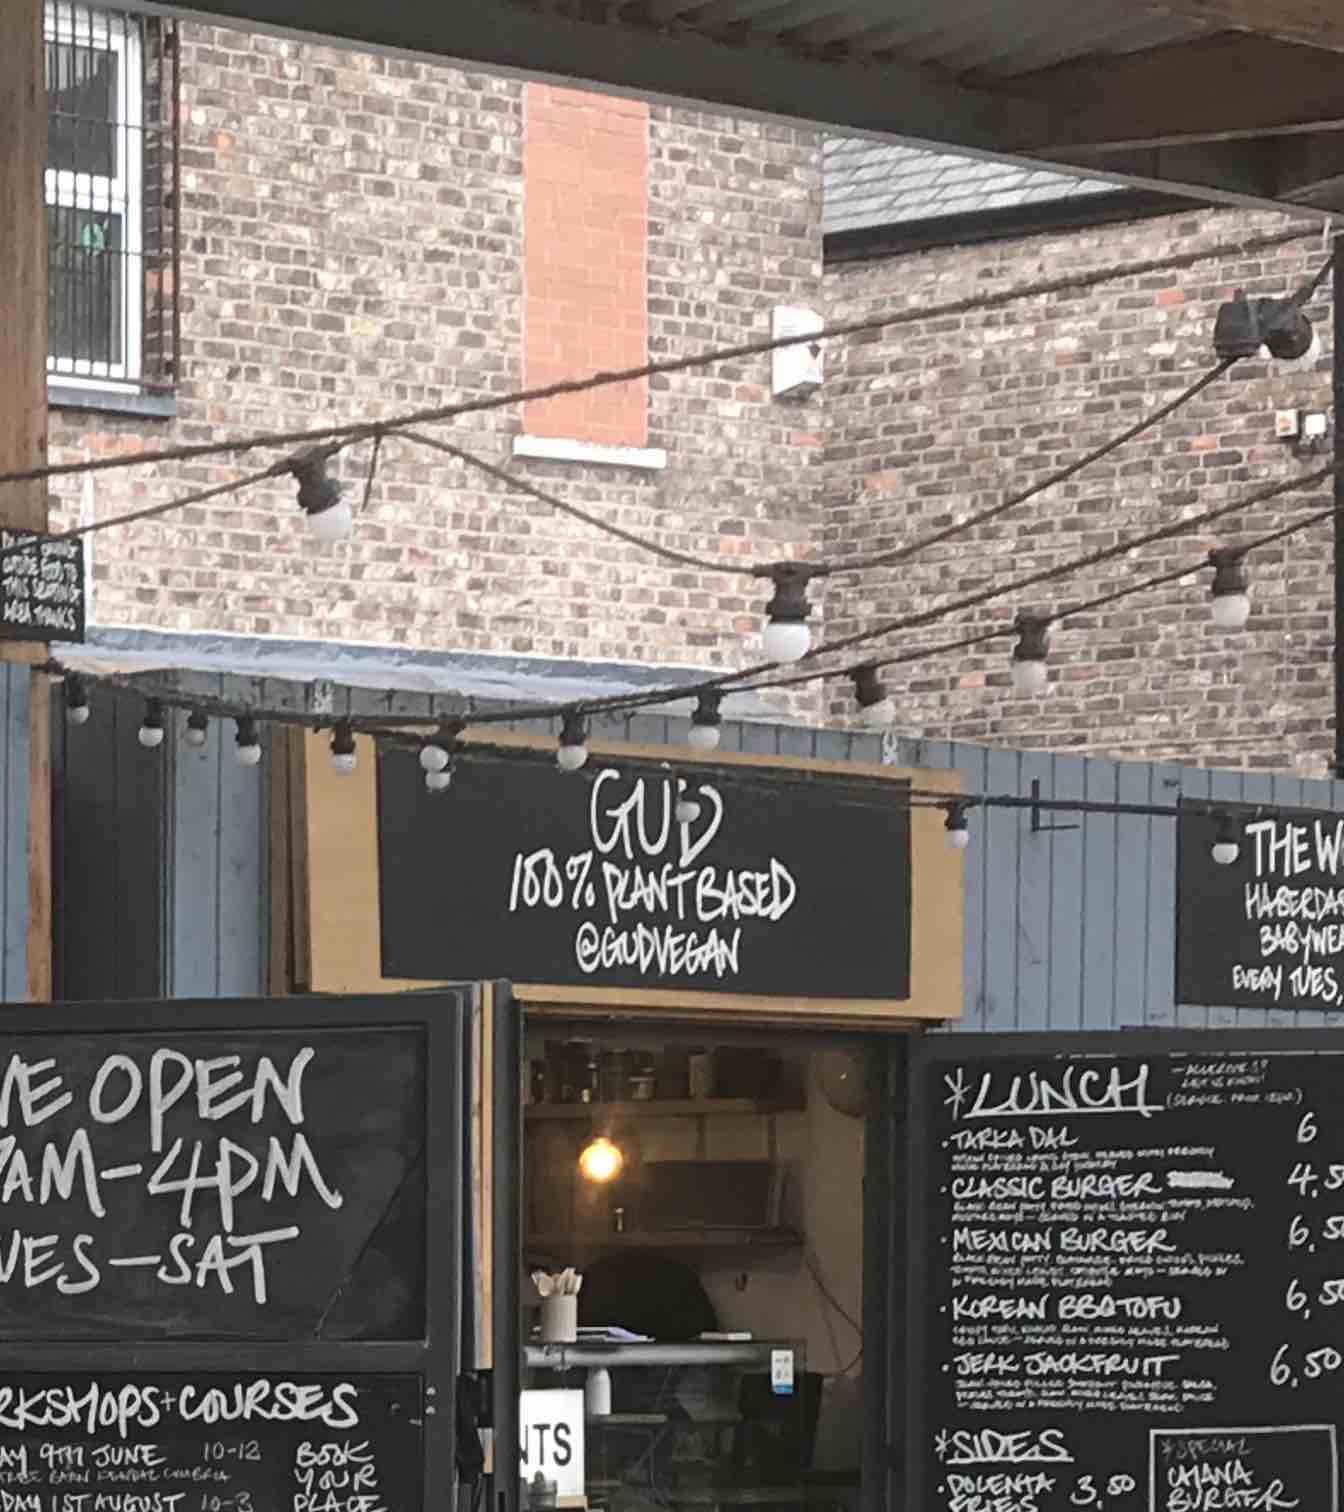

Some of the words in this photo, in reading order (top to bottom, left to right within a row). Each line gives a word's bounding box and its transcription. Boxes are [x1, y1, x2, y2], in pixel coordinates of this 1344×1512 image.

[590, 768, 724, 868] GUD
[1245, 820, 1311, 877] THE
[509, 848, 595, 911] 100%
[605, 862, 699, 924] PLANT
[696, 857, 796, 923] BASED
[575, 921, 742, 978] @GUDVEGAN
[1232, 965, 1282, 1001] EVERY
[1288, 965, 1344, 1005] TUES,
[88, 1048, 315, 1153] OPEN
[951, 1127, 1024, 1149] TARKA
[1028, 1126, 1079, 1148] DAL
[1297, 1112, 1317, 1144] 6
[951, 1177, 1047, 1199] CLASSIC
[1050, 1173, 1162, 1199] BURGER
[952, 1227, 1052, 1253] MEXICAN
[1060, 1226, 1177, 1254] BURGER
[951, 1295, 1049, 1320] KOREAN
[1057, 1295, 1116, 1319] BBQ
[1116, 1296, 1182, 1319] TOFU
[955, 1352, 1019, 1376] JERK
[1024, 1351, 1181, 1376] JACKFRUIT
[39, 1442, 83, 1470] 9TH
[91, 1444, 168, 1468] JUNE
[203, 1440, 262, 1462] 10-12
[295, 1441, 375, 1466] BOOK
[293, 1465, 378, 1492] YOUR
[945, 1473, 1057, 1496] POLENTA
[1166, 1459, 1254, 1486] CHANA
[93, 1492, 186, 1512] AUGUST
